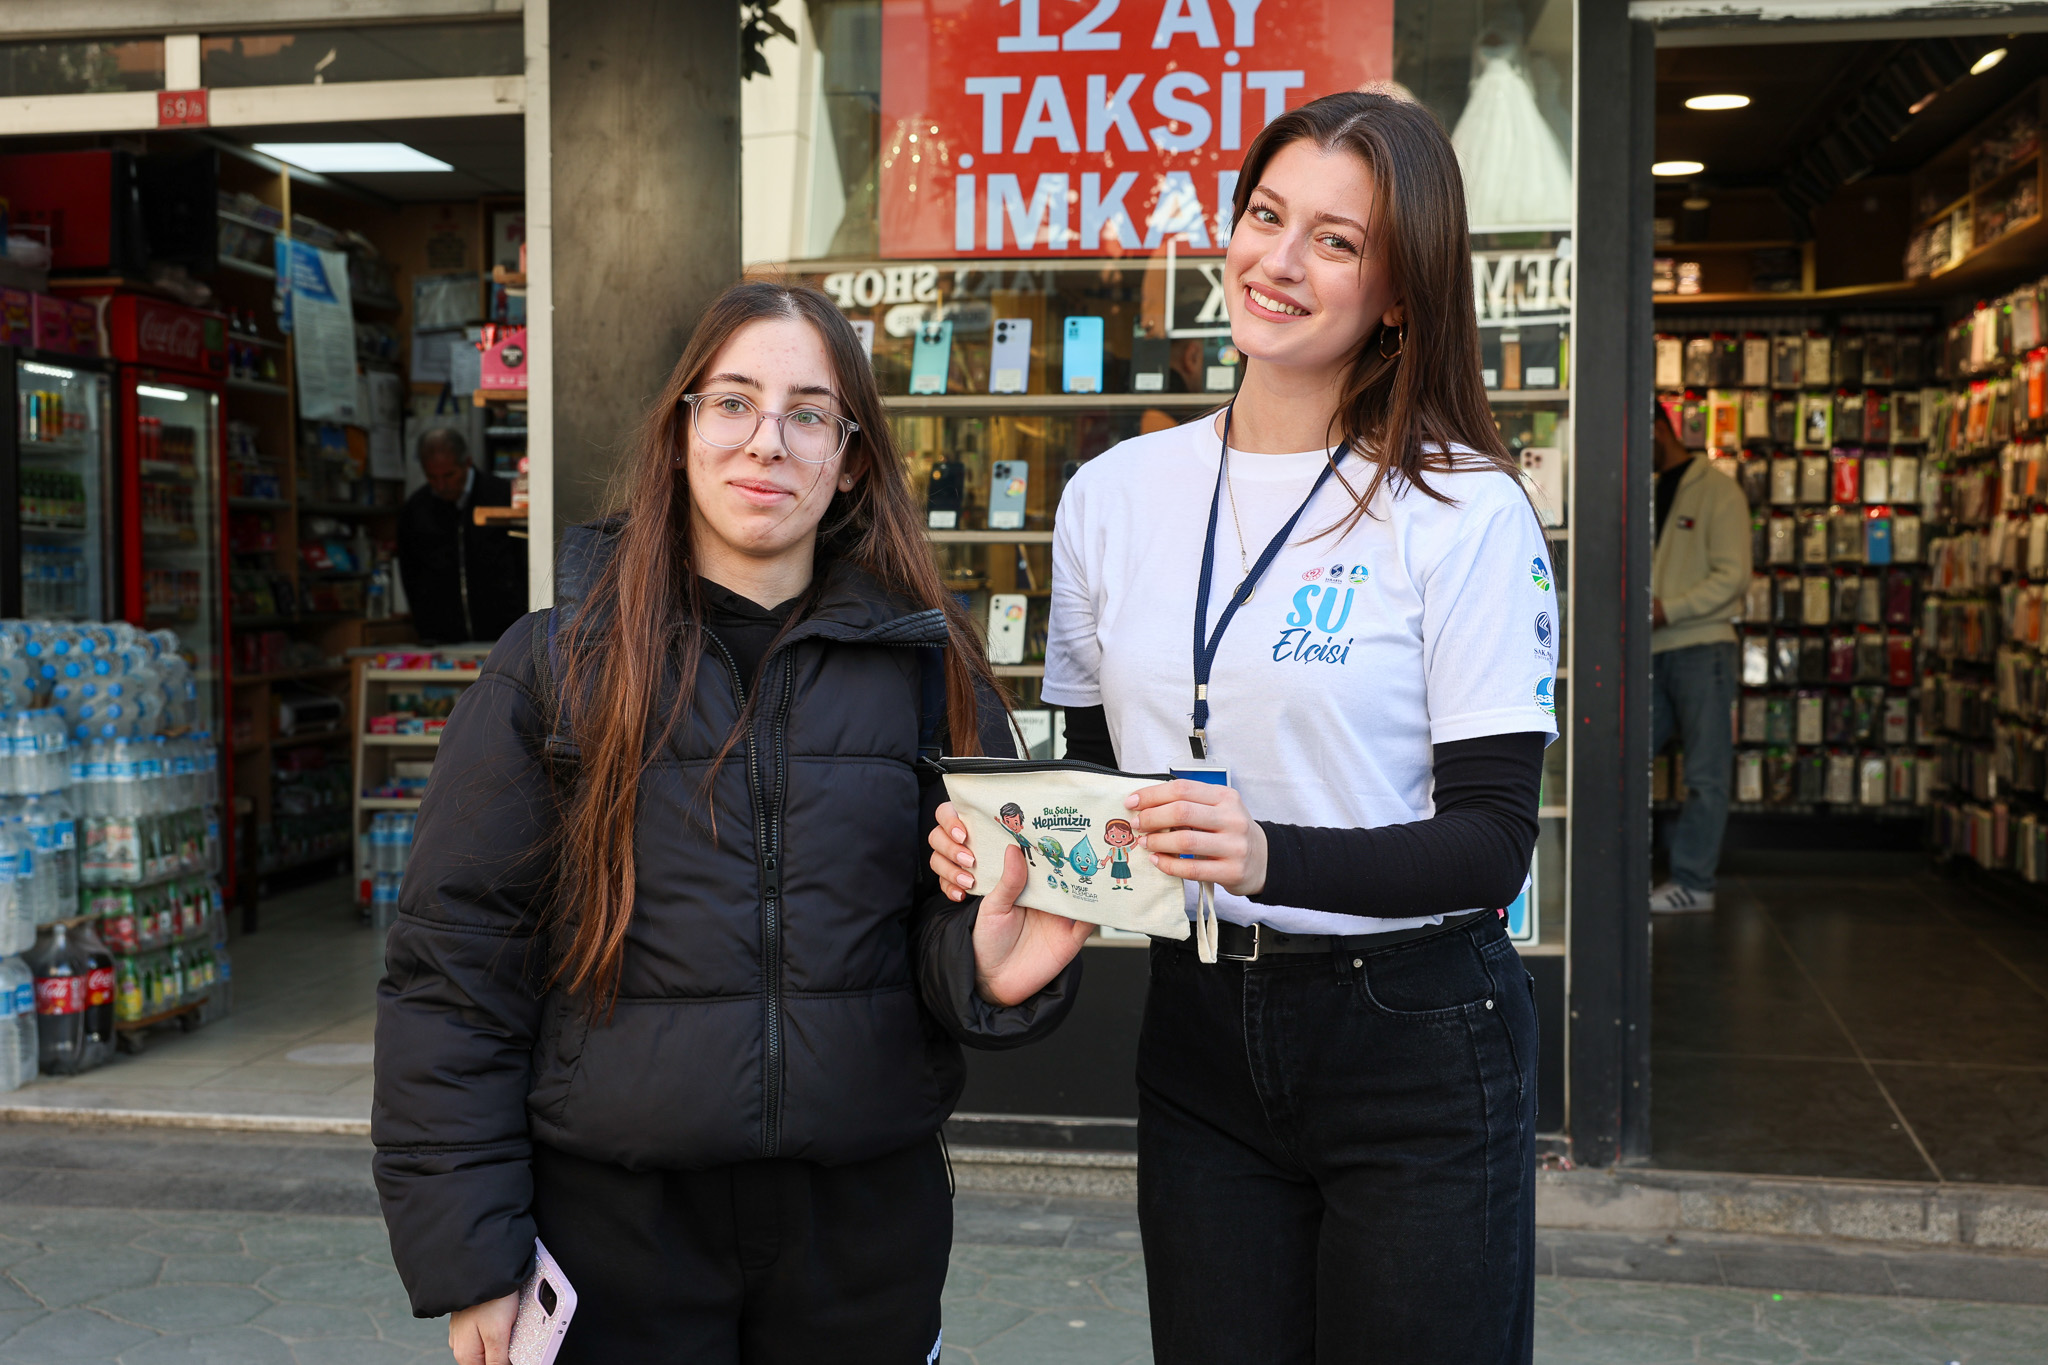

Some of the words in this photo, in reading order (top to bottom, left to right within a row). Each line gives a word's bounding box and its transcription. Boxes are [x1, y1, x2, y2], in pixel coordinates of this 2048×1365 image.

[998, 0, 1121, 53] 12
[1151, 0, 1263, 49] AY
[965, 50, 1305, 154] TAKSİT
[1286, 584, 1355, 634] SU
[1272, 628, 1354, 665] Elçisi
[1032, 814, 1091, 830] Hepimizin
[1043, 807, 1054, 816] Bu
[1055, 806, 1078, 817] Şehir
